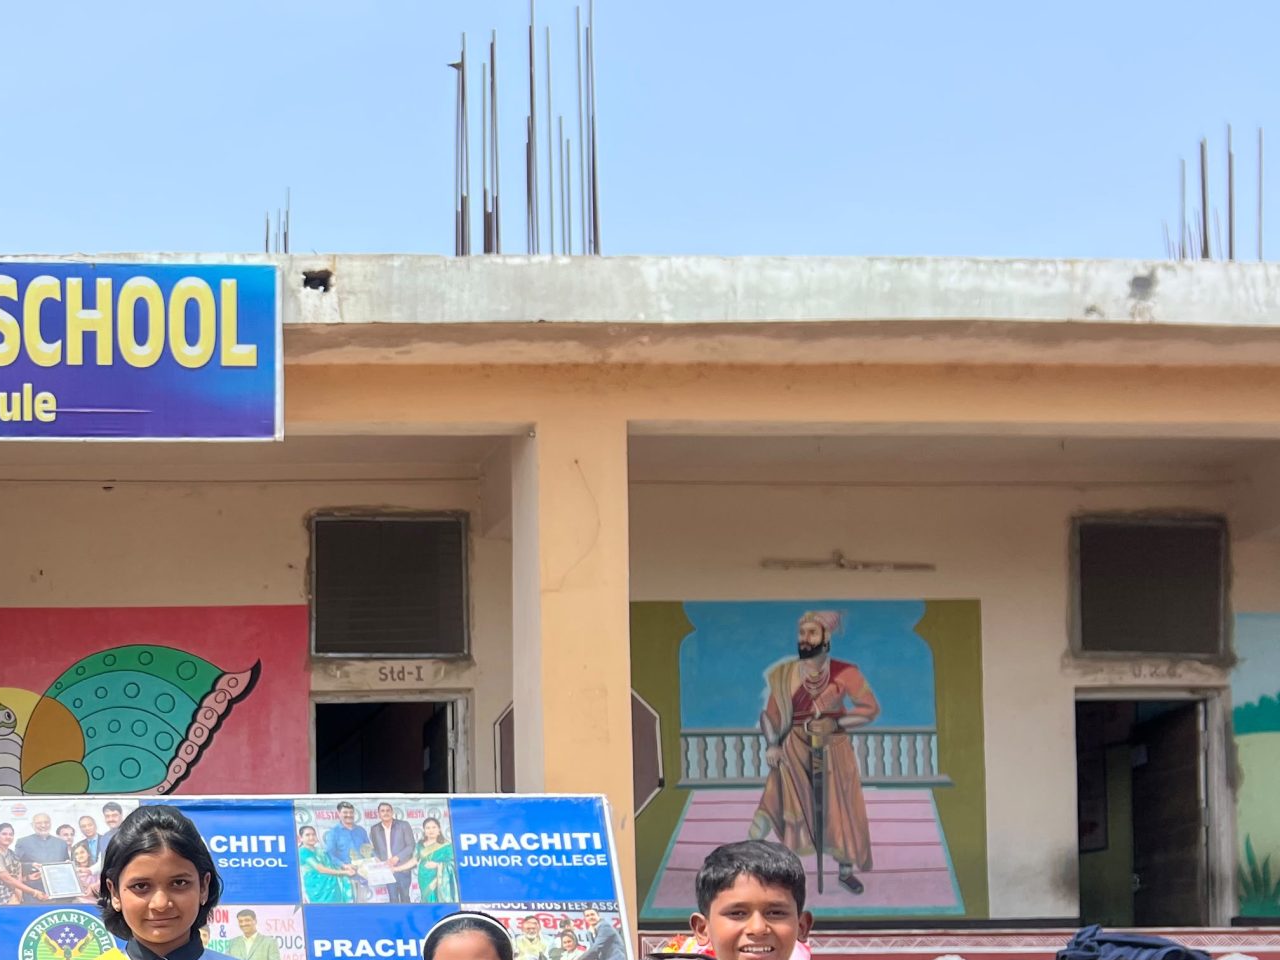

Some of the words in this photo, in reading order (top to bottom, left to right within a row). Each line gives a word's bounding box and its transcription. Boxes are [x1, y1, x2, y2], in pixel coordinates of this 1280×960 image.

[378, 666, 424, 681] Std-I
[460, 832, 602, 851] PRACHITI
[218, 858, 288, 867] SCHOOL
[460, 855, 523, 867] JUNIOR
[526, 854, 608, 867] COLLEGE
[29, 912, 88, 940] PRIMARY
[265, 918, 296, 932] STAR
